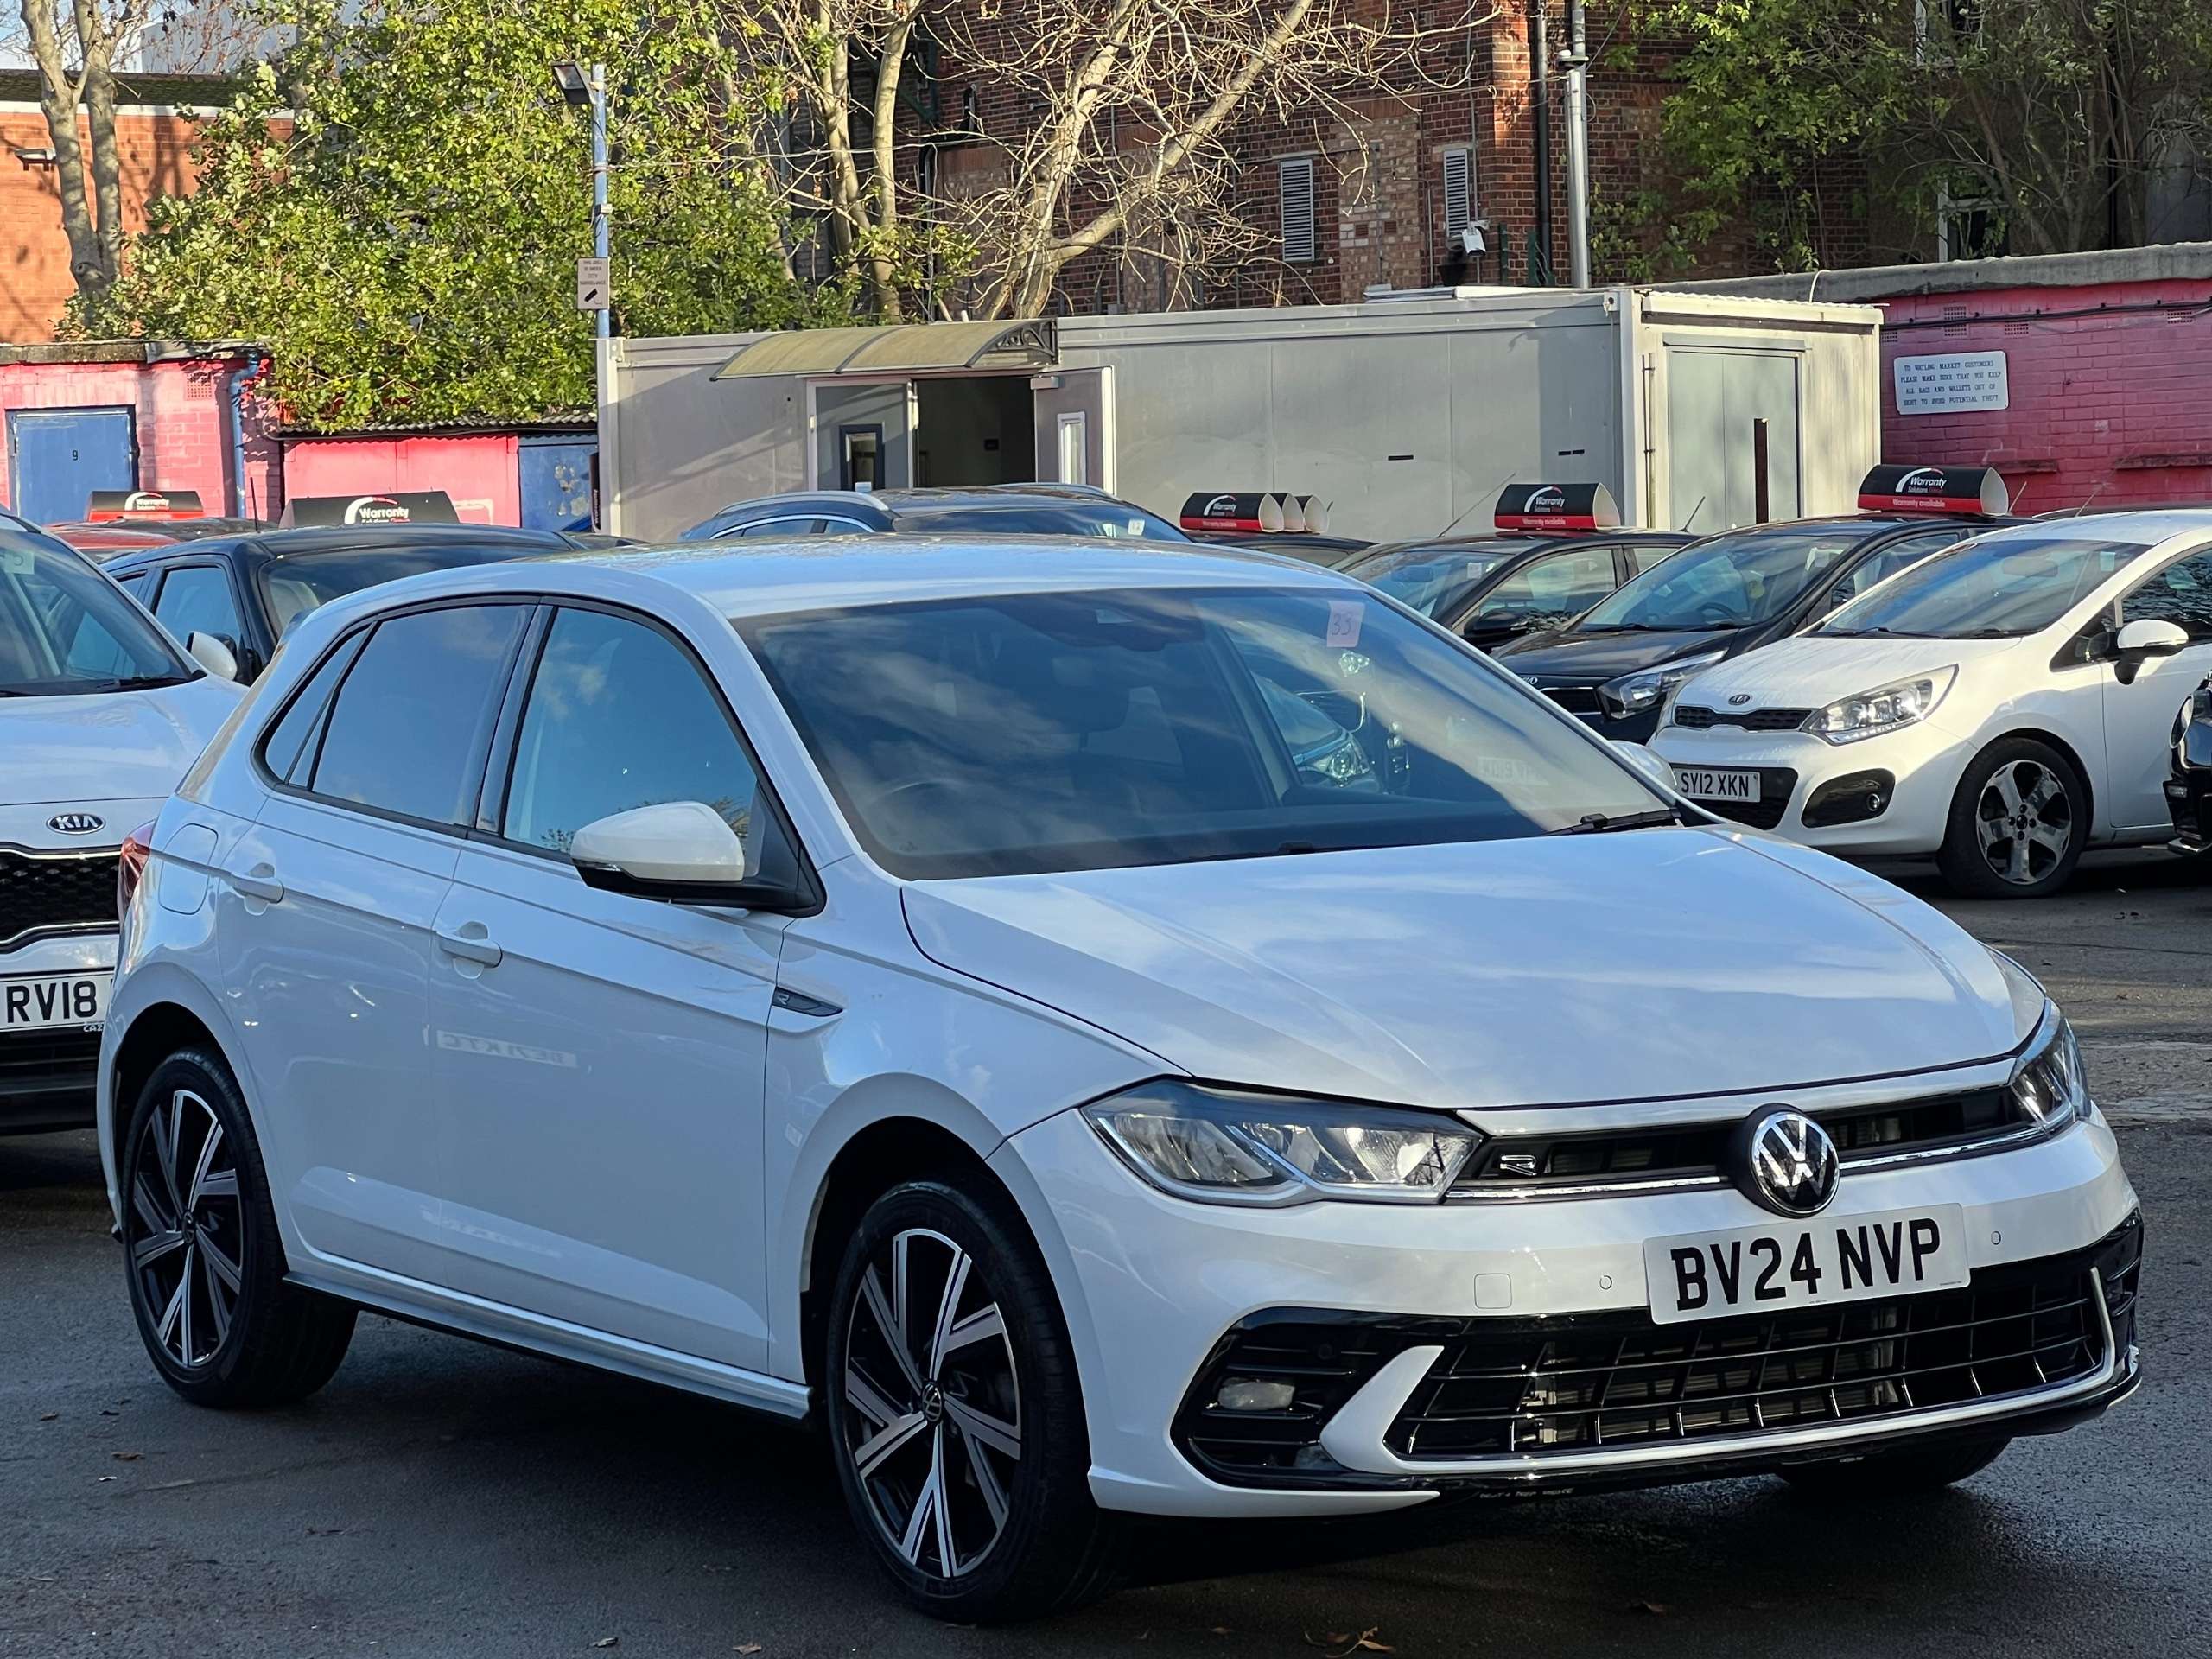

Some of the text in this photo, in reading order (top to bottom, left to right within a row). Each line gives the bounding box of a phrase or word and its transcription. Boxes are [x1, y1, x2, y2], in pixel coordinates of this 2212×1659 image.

[72, 449, 79, 461] 9
[1910, 476, 1947, 488] Warranty
[1535, 497, 1566, 507] Warranty
[1892, 499, 1918, 508] Warranty
[359, 507, 409, 518] Warranty
[1681, 772, 1750, 798] SY12 XKN
[55, 815, 99, 830] KIA
[6, 980, 97, 1024] RV18
[1670, 1217, 1941, 1312] BV24 NVP
